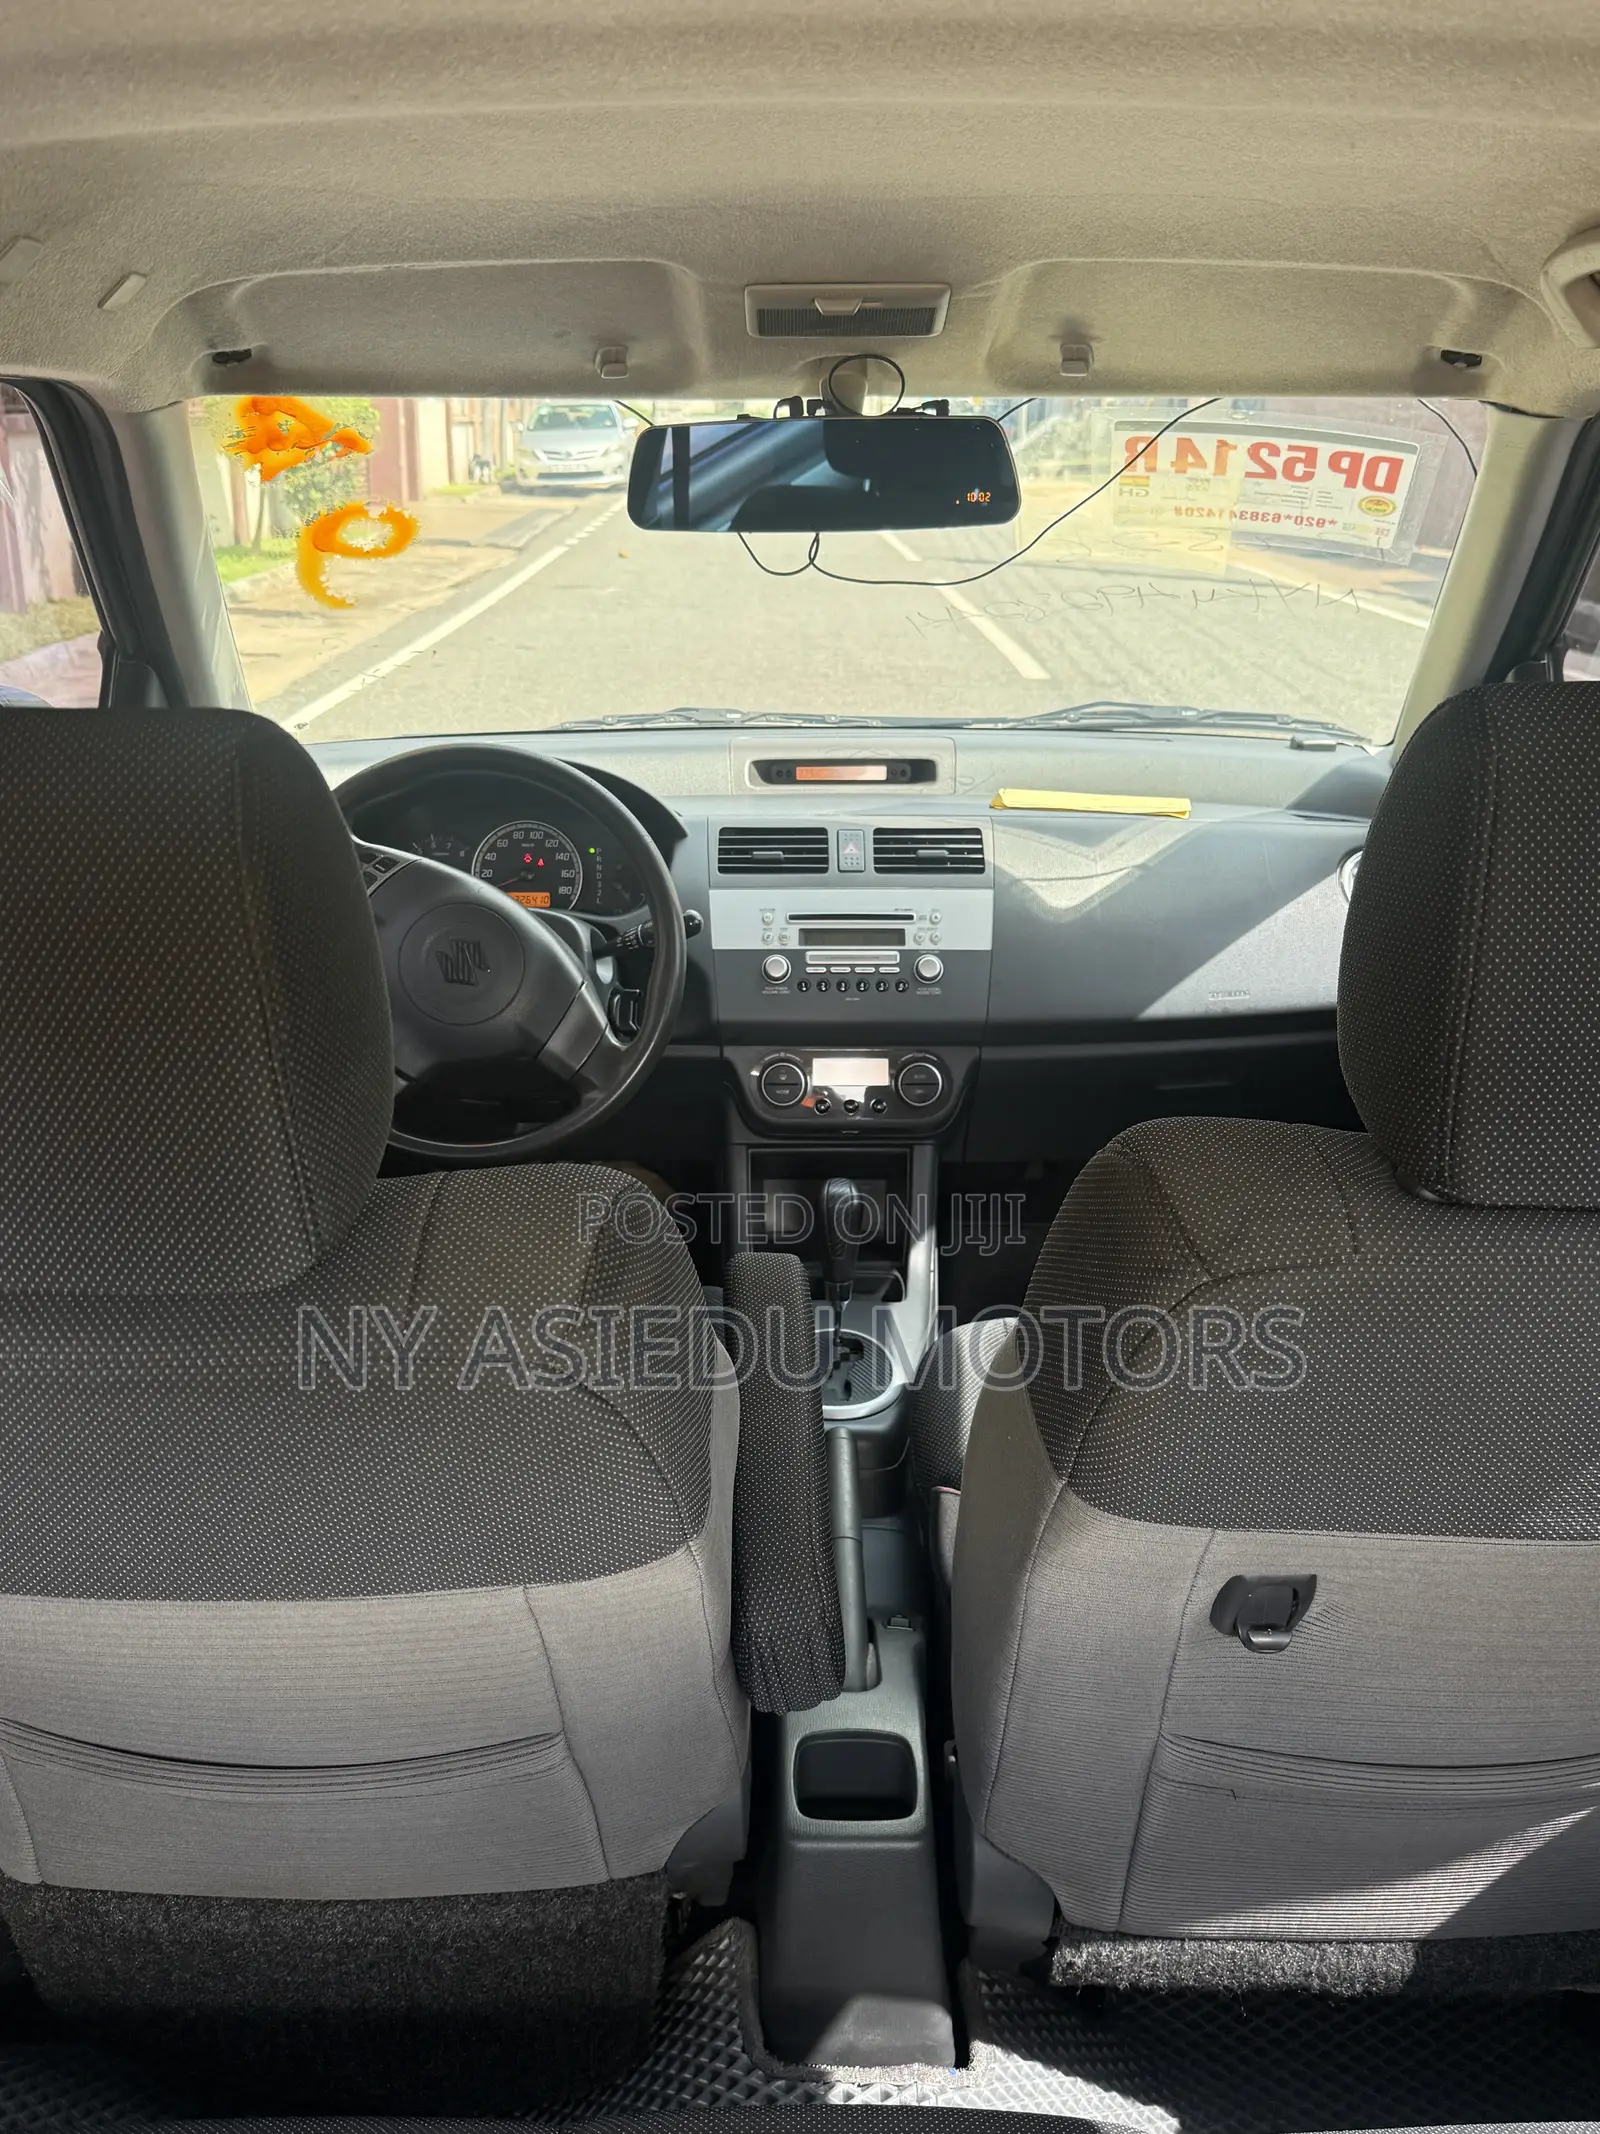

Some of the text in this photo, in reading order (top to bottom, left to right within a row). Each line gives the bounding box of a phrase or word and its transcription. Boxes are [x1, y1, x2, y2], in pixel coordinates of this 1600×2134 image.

[513, 831, 544, 839] 80 100
[496, 839, 508, 848] 60
[545, 839, 559, 848] 120
[484, 853, 497, 861] 40
[555, 853, 570, 861] 140
[481, 869, 493, 878] 20
[561, 870, 575, 878] 160
[558, 886, 572, 895] 180
